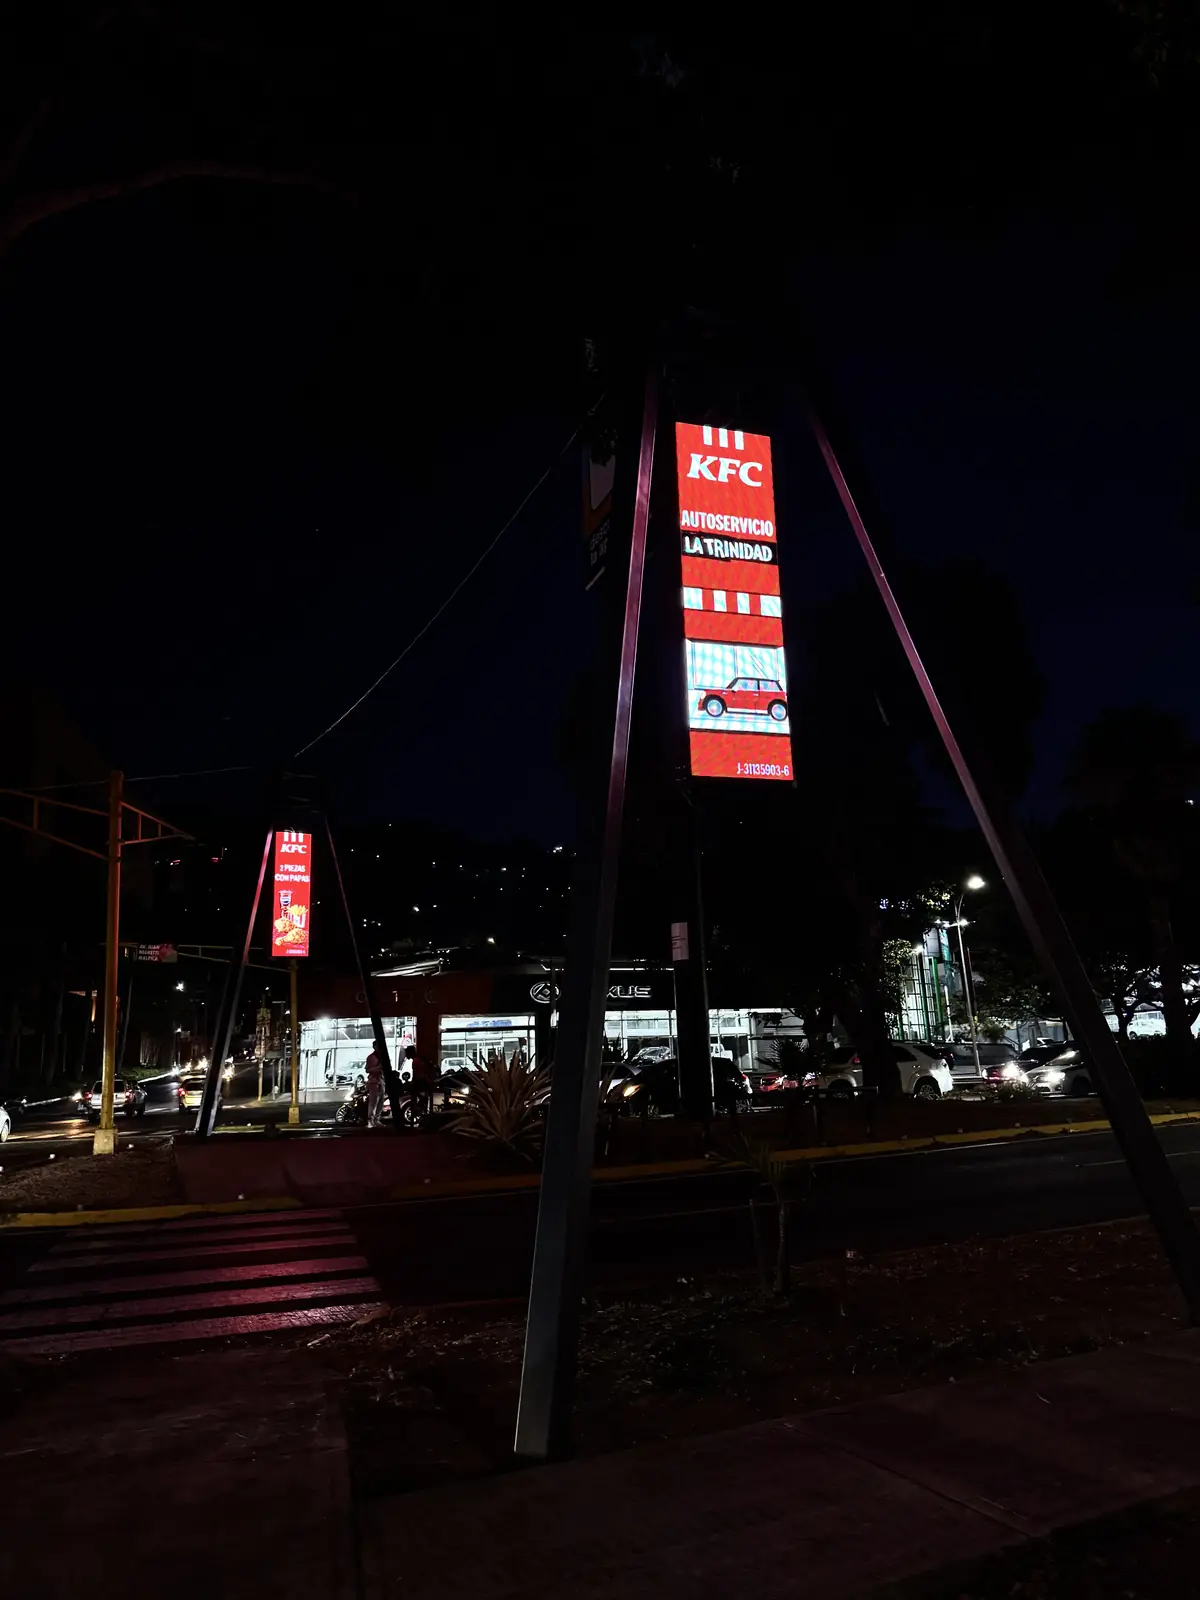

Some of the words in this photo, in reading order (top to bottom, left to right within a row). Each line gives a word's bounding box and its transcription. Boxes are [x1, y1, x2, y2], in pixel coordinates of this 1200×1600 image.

[686, 453, 763, 488] KFC
[681, 510, 774, 537] AUTOSERVICIO
[684, 536, 704, 555] LA
[703, 538, 773, 562] TRINIDAD
[737, 762, 790, 777] J-31135903-6
[280, 843, 308, 854] KFC
[279, 864, 284, 872] 2
[284, 864, 306, 873] PIEZAS
[274, 873, 289, 882] CON
[289, 874, 311, 883] PAPAS
[606, 985, 652, 998] XUS
